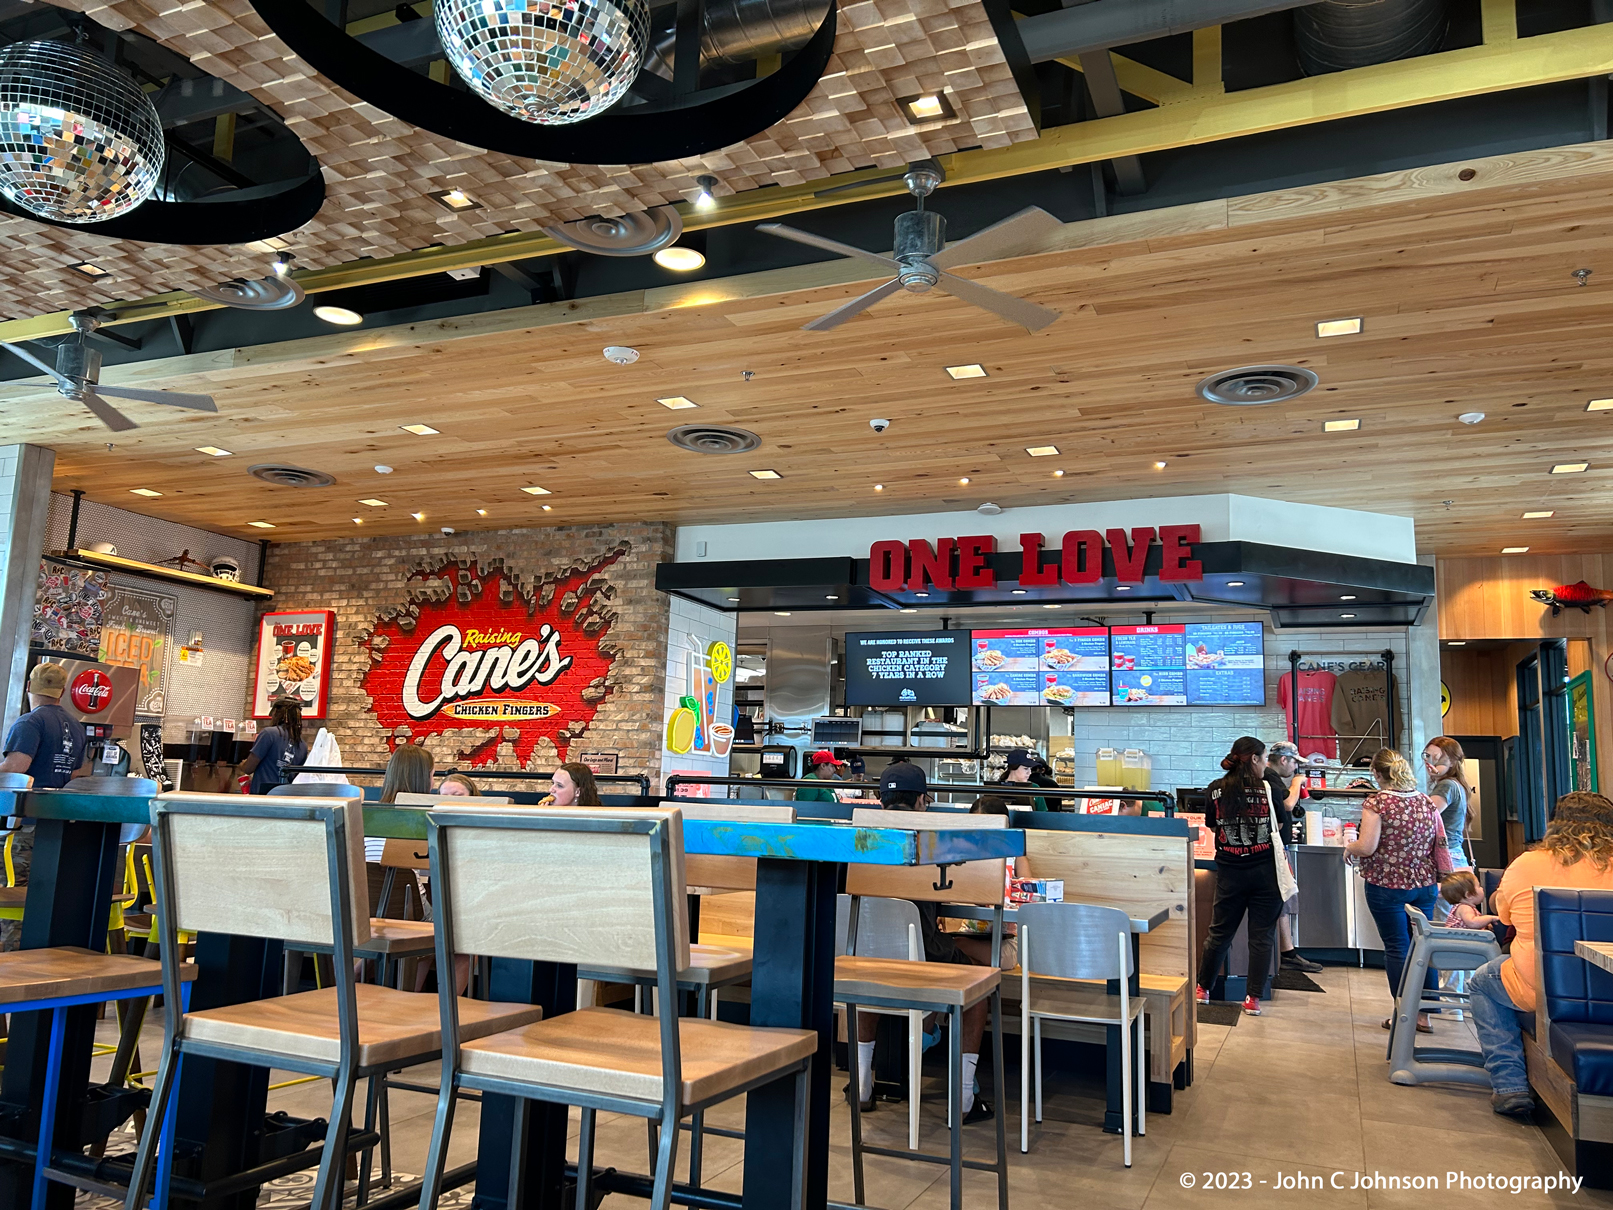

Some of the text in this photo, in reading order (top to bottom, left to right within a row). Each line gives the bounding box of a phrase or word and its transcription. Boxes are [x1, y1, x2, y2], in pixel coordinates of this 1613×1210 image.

[870, 524, 1202, 592] ONE LOVE
[273, 623, 322, 637] ONE LOVE
[463, 628, 522, 648] Raising
[106, 632, 153, 661] ICED
[403, 624, 573, 720] Cane's
[1298, 662, 1385, 671] CANE'S GEAR
[1089, 800, 1113, 813] CANIAC
